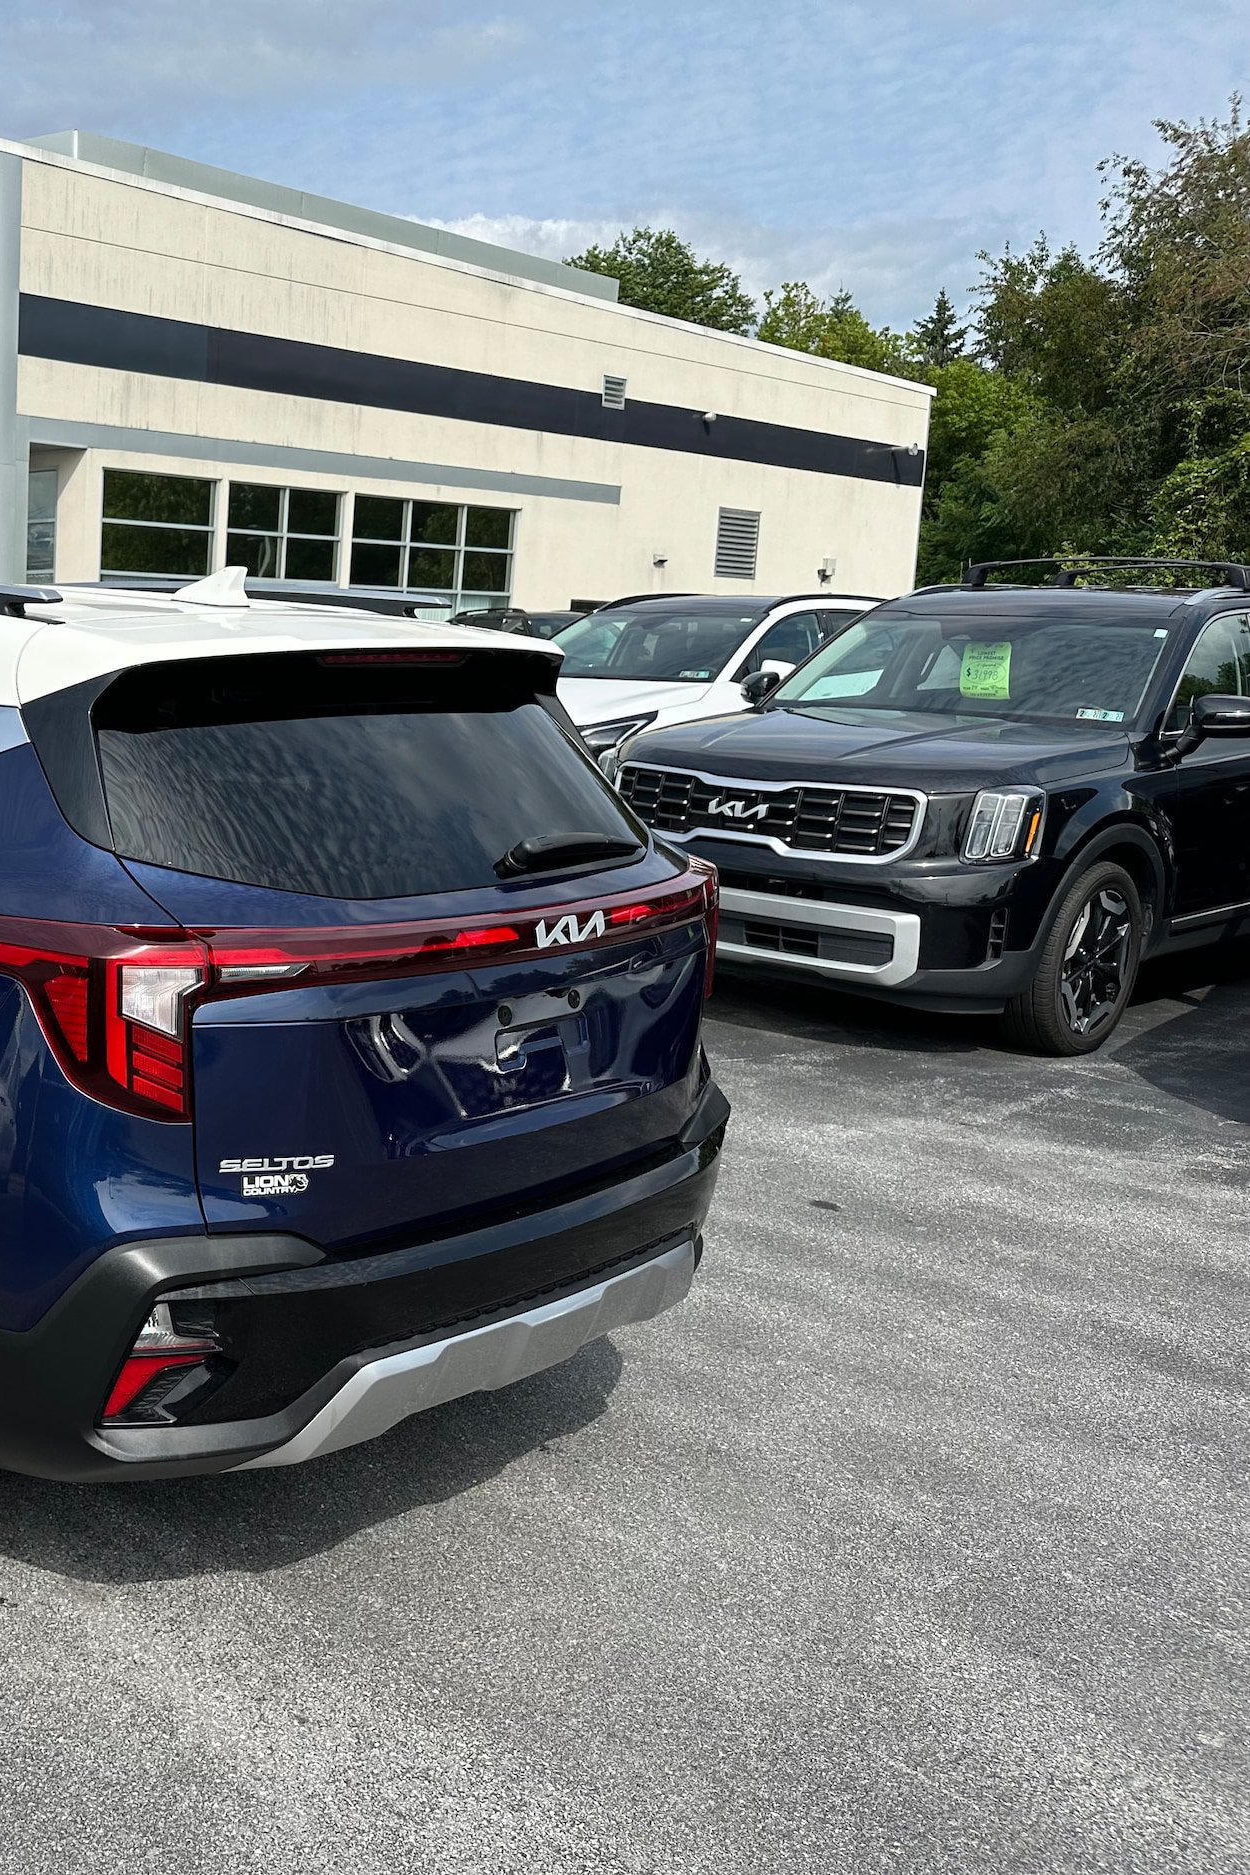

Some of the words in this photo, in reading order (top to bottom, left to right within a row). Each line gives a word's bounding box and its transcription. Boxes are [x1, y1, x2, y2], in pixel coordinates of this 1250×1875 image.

[708, 797, 770, 820] KIA
[535, 910, 606, 949] KIA
[218, 1154, 335, 1174] SELTOS
[243, 1174, 290, 1189] LION
[243, 1185, 297, 1197] COUNTRY
